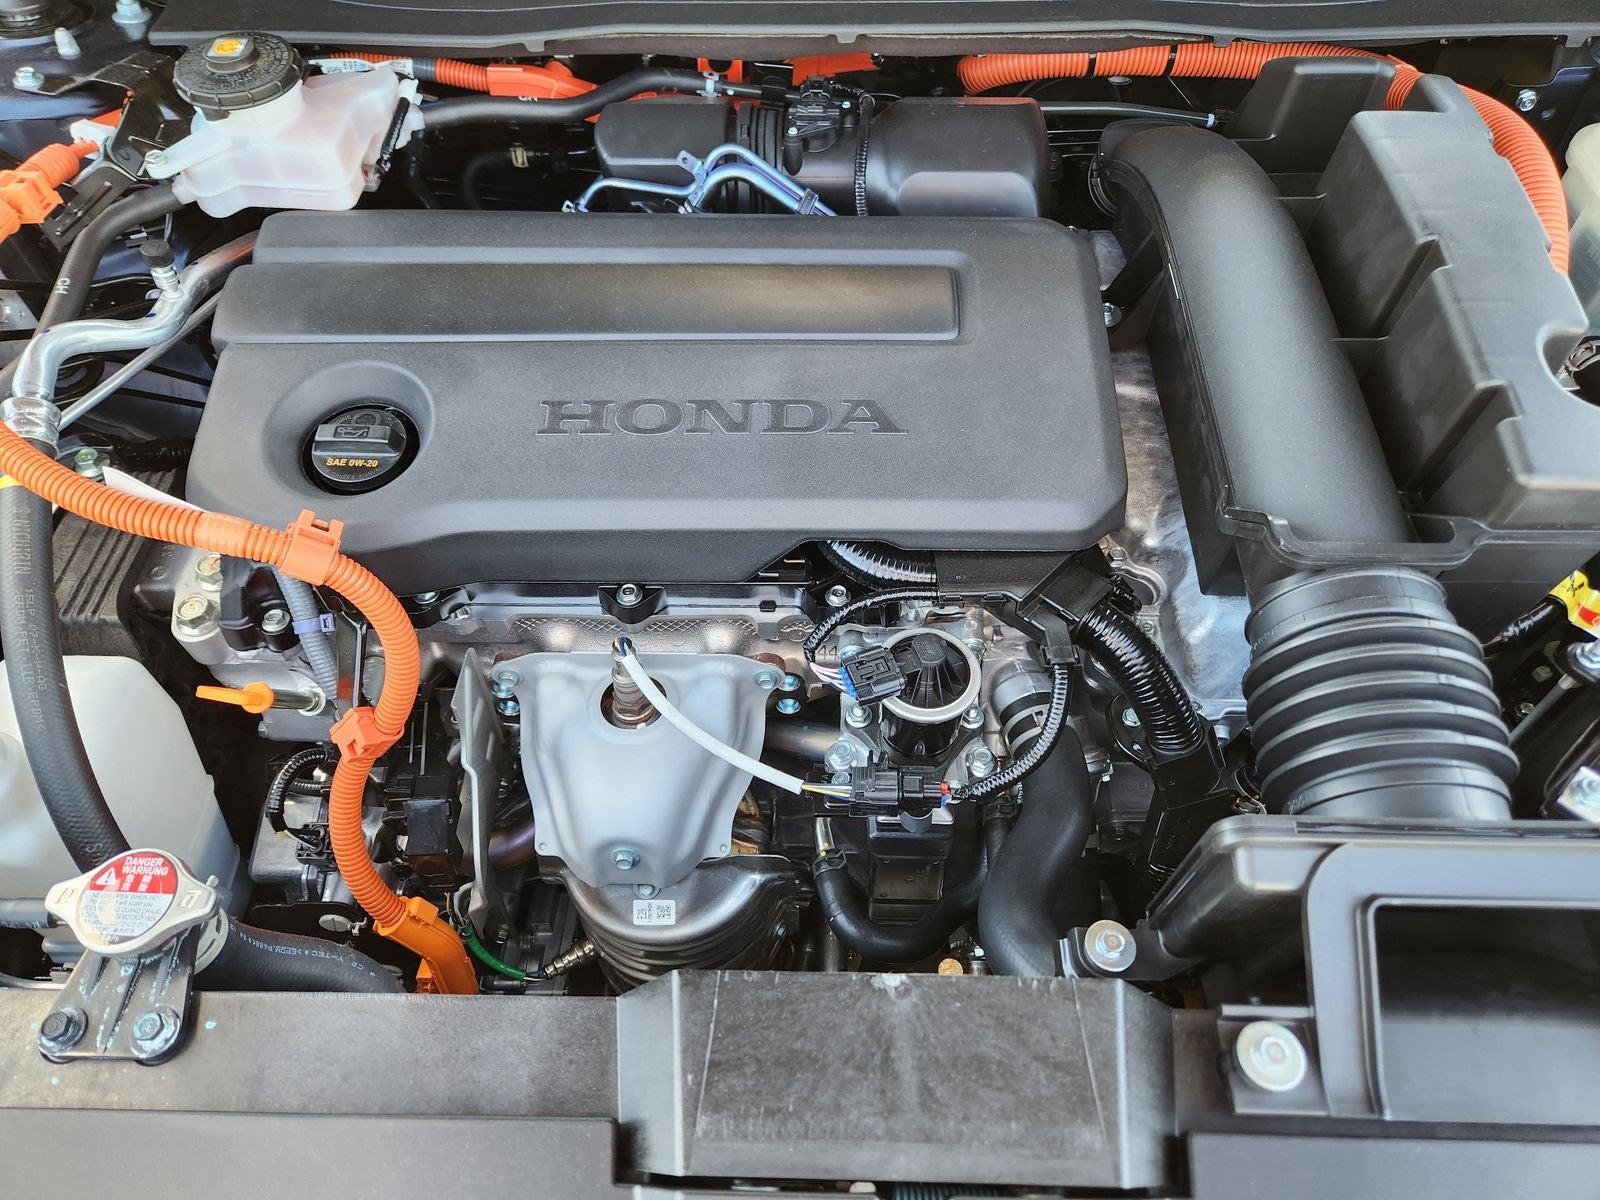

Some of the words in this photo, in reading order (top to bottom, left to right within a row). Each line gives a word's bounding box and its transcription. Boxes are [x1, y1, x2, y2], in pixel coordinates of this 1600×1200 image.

[535, 399, 909, 436] HONDA
[325, 458, 348, 466] SAE
[348, 459, 379, 468] 0W-20
[124, 856, 164, 867] DANGER
[122, 865, 169, 876] WARNUNG
